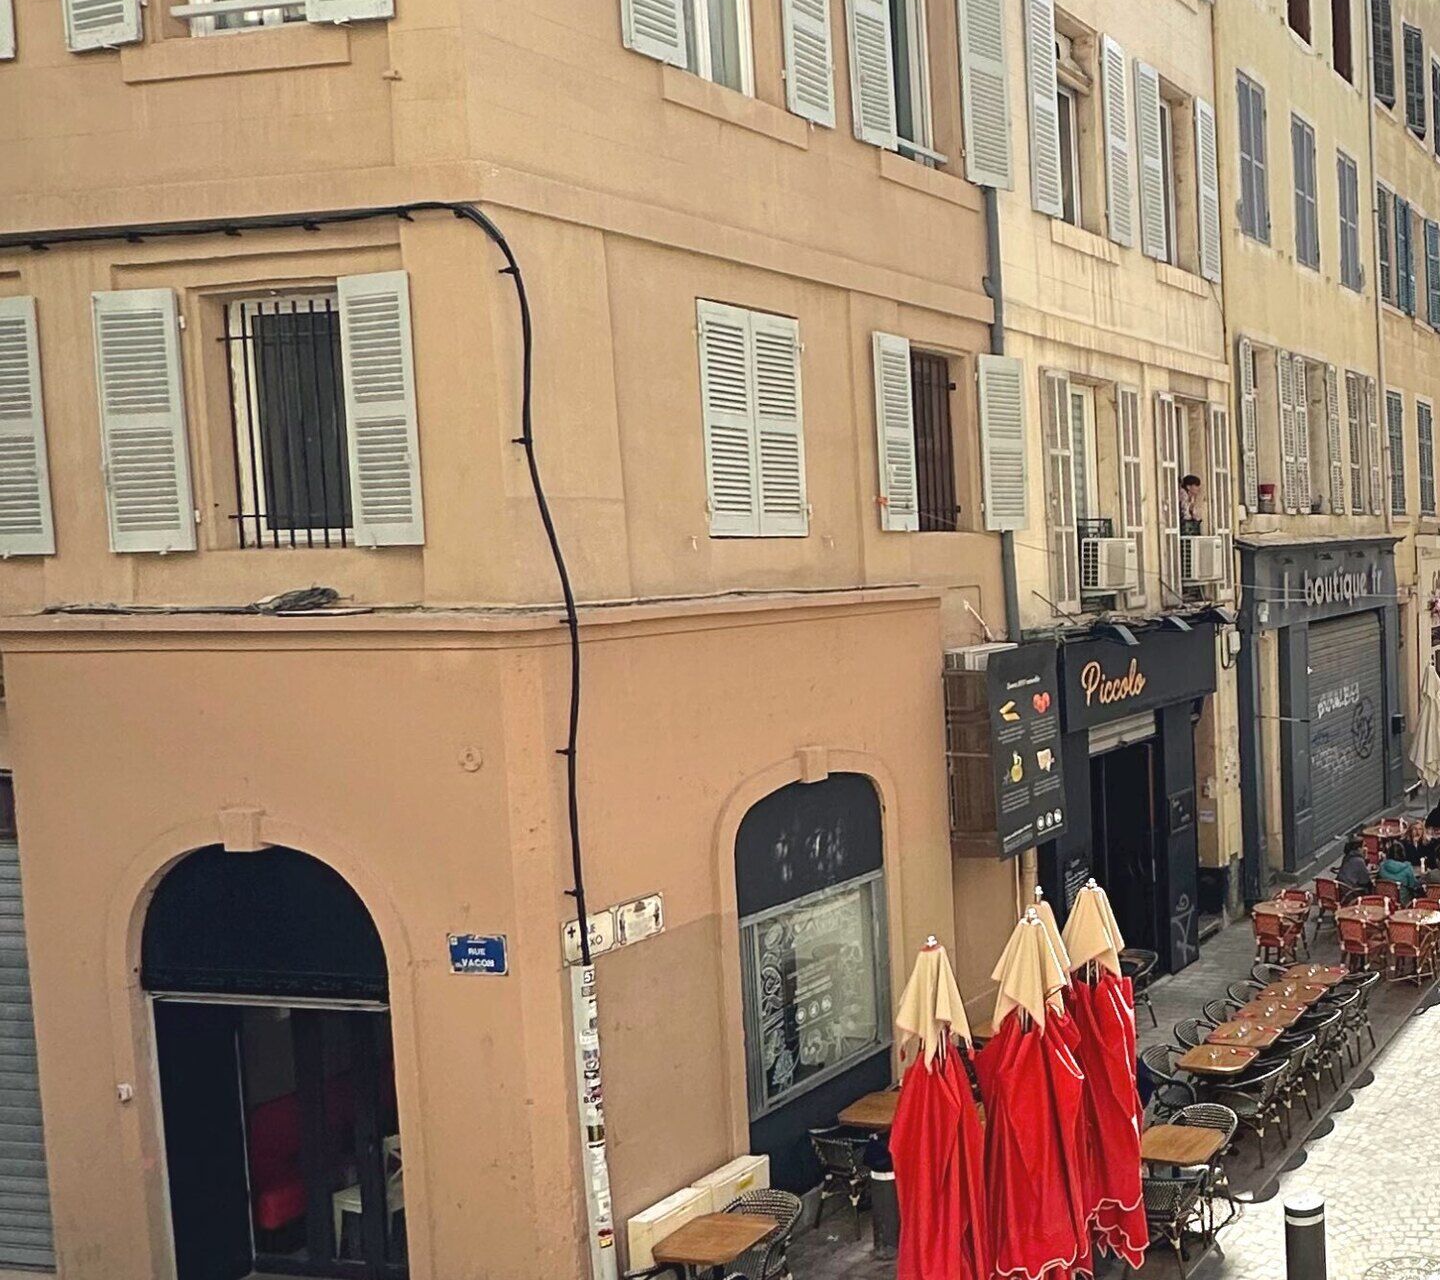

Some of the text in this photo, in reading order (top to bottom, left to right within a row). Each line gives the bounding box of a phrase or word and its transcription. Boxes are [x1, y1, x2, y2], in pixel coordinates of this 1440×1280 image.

[1304, 566, 1367, 607] boutique
[1081, 658, 1146, 707] Piccolo
[576, 933, 603, 951] HXO
[468, 947, 486, 957] RUE
[461, 959, 495, 968] VACON
